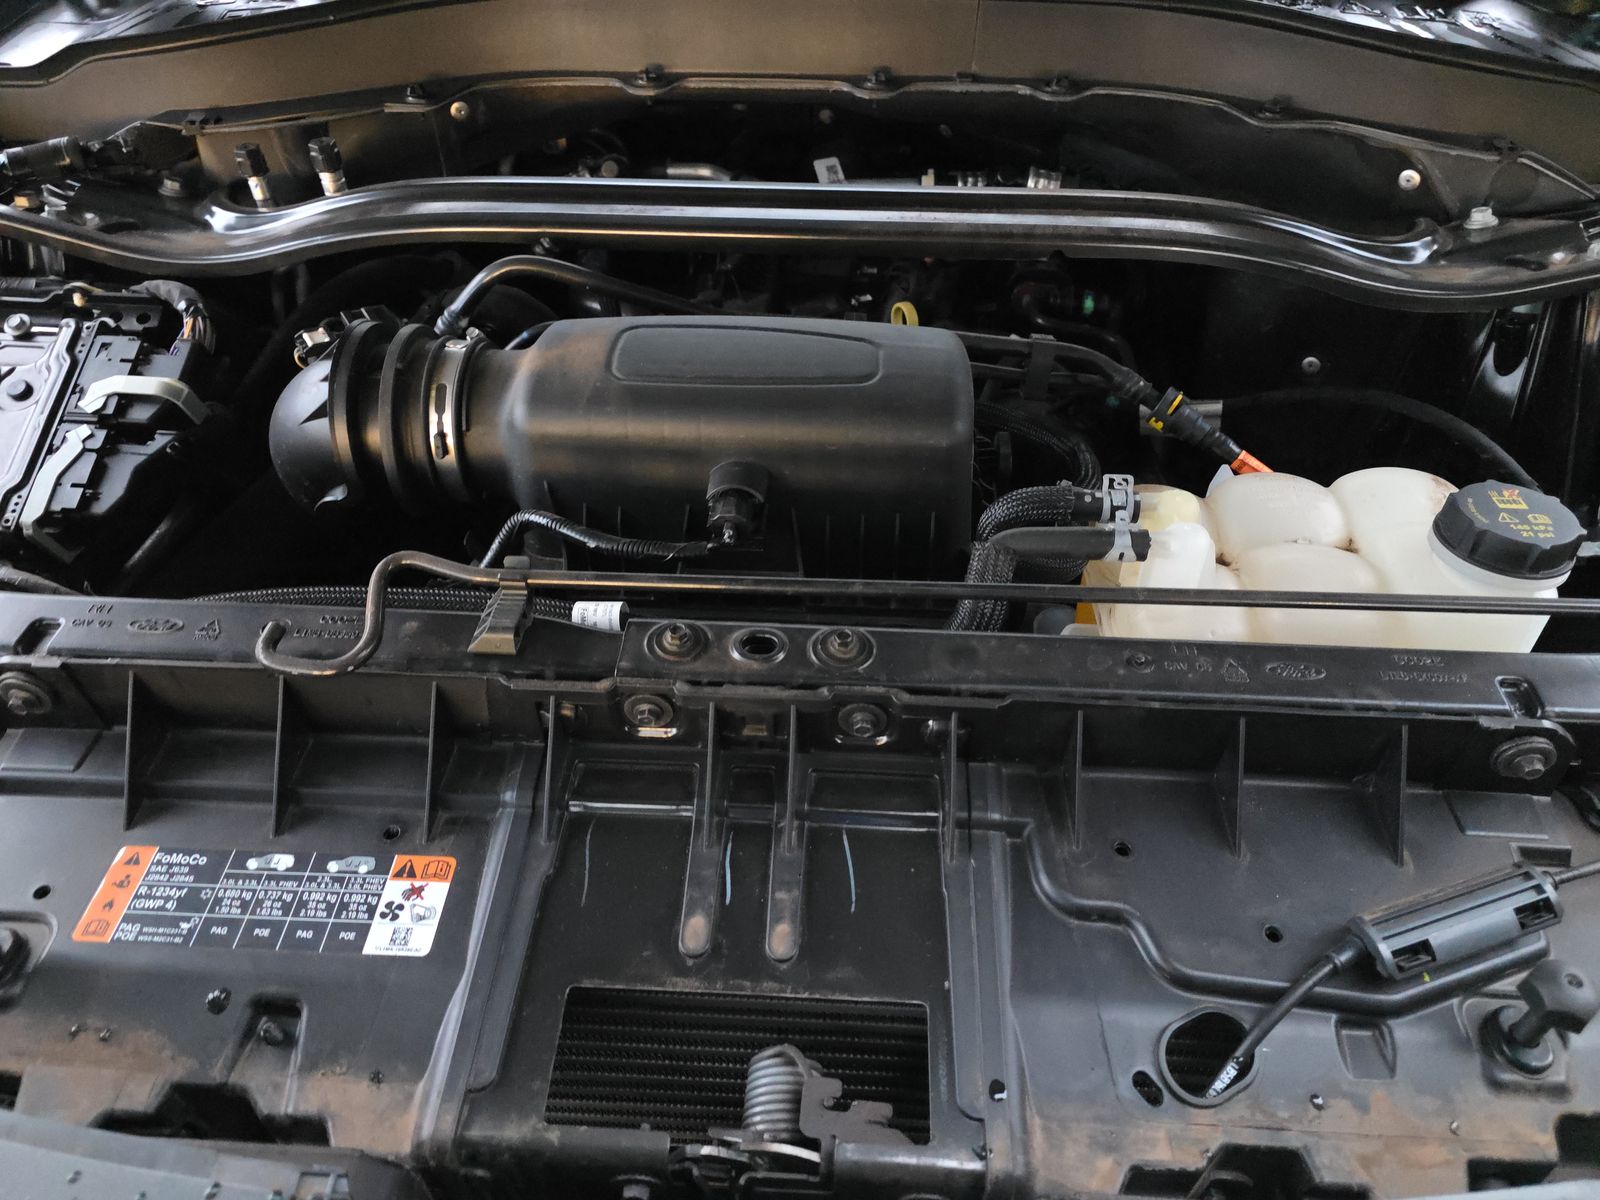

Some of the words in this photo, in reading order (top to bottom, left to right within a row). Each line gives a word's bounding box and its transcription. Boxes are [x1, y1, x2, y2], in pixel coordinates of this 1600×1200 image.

[153, 853, 208, 865] FoMoCo
[149, 865, 168, 873] SAE
[168, 866, 190, 874] J639
[137, 885, 188, 898] R-1234yf
[217, 888, 241, 898] 0.680
[241, 889, 253, 900] kg
[258, 891, 281, 900] 0.737
[282, 891, 294, 902] kg
[302, 892, 325, 901] 0.992
[326, 892, 338, 903] kg
[343, 893, 366, 903] 0.992
[366, 894, 379, 905] kg
[131, 899, 164, 910] (GWP
[165, 900, 177, 912] 4)
[271, 908, 283, 916] lbs
[315, 909, 327, 917] lbs
[356, 911, 369, 919] lbs
[117, 922, 141, 932] PAG
[210, 926, 228, 935] PAG
[113, 931, 137, 942] POE
[253, 928, 271, 937] POE
[295, 929, 314, 939] PAG
[338, 931, 357, 941] POE
